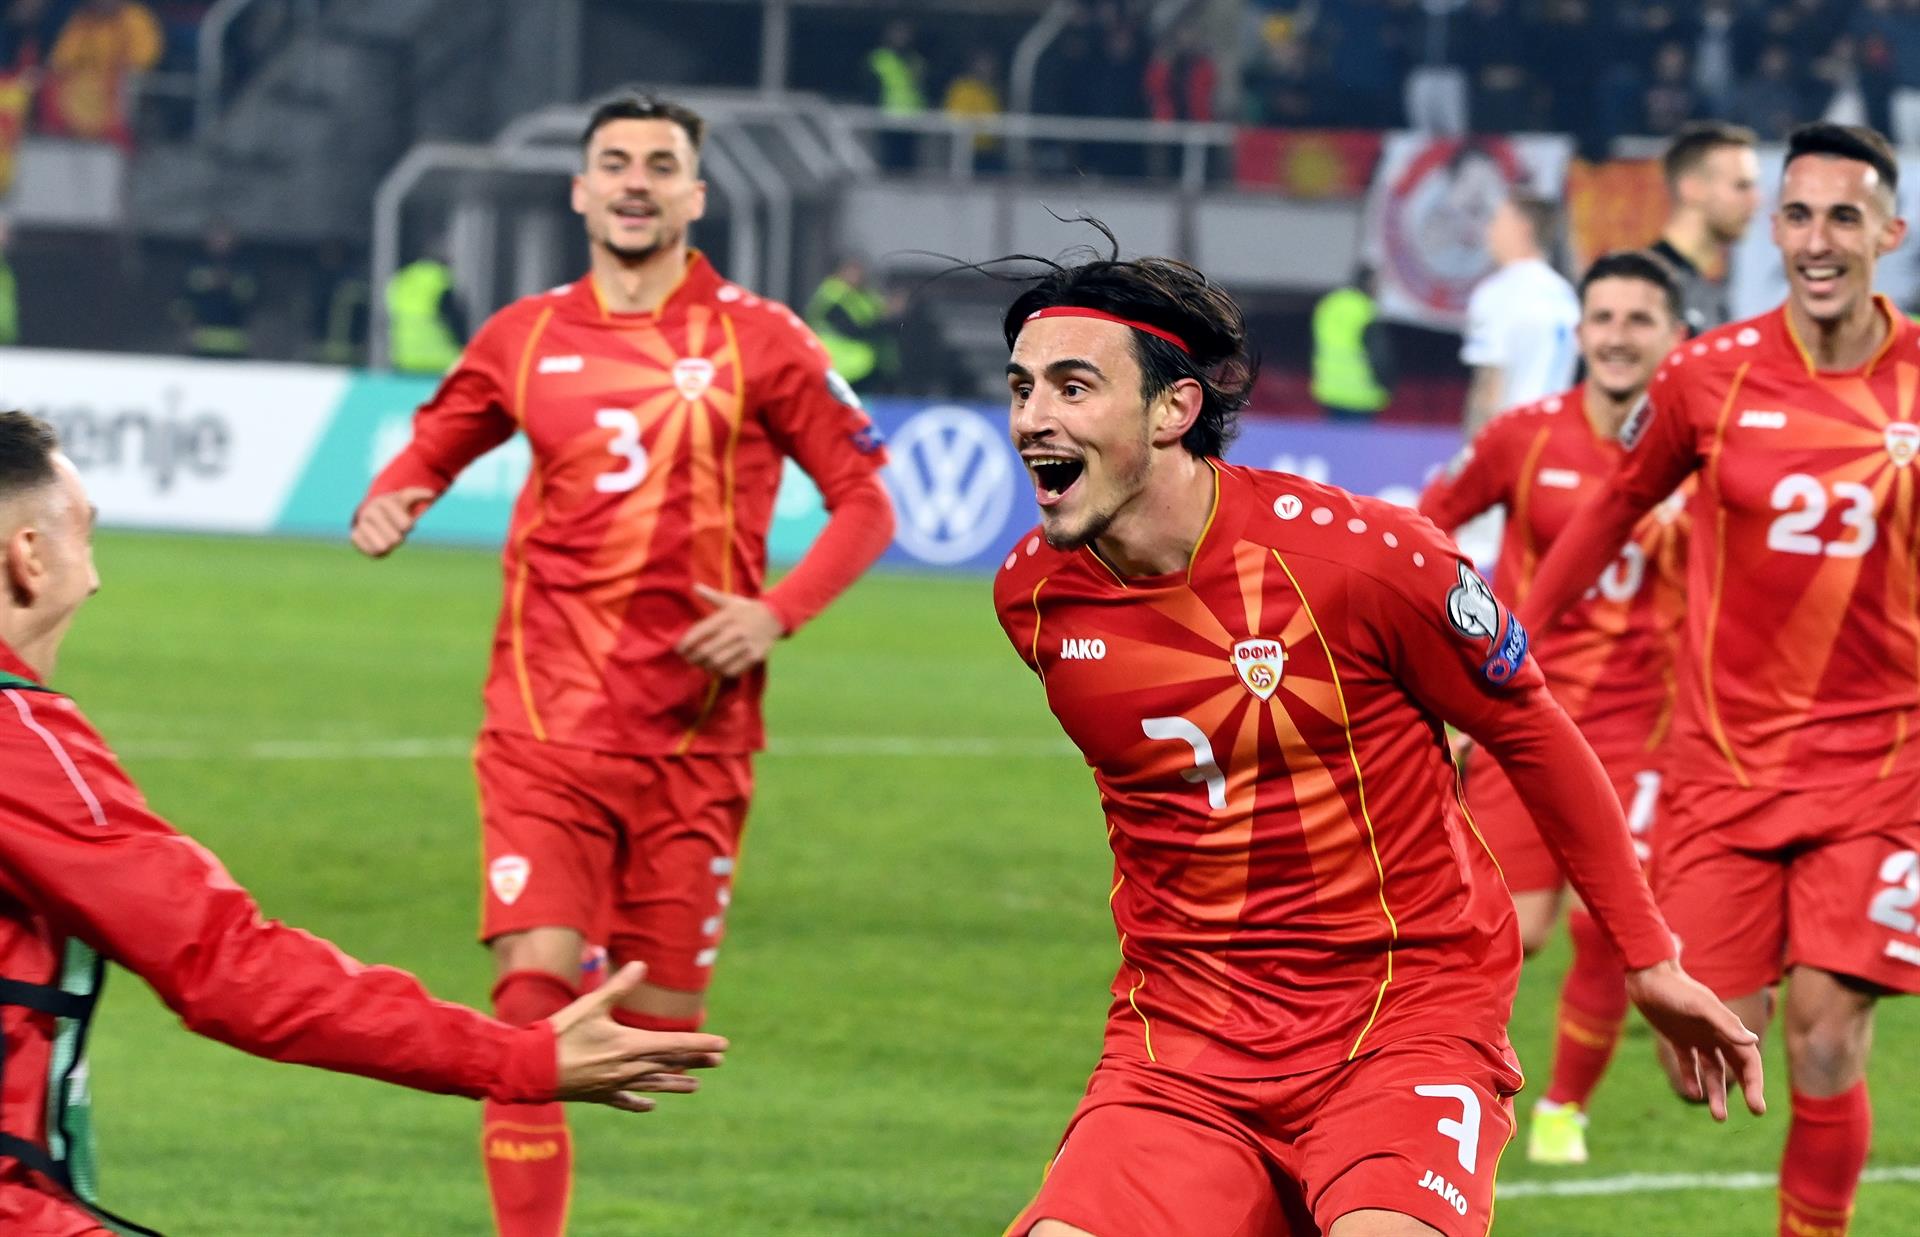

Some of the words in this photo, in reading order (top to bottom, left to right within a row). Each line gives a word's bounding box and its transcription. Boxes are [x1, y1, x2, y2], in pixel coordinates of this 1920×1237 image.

[42, 386, 230, 493] enje
[595, 409, 648, 493] 3
[1767, 474, 1877, 558] 23
[1584, 542, 1646, 602] 0
[1061, 638, 1106, 660] JAKO
[1141, 716, 1227, 810] 7
[1867, 850, 1920, 933] 2
[1414, 1085, 1481, 1175] 7
[1418, 1169, 1467, 1216] JAKO
